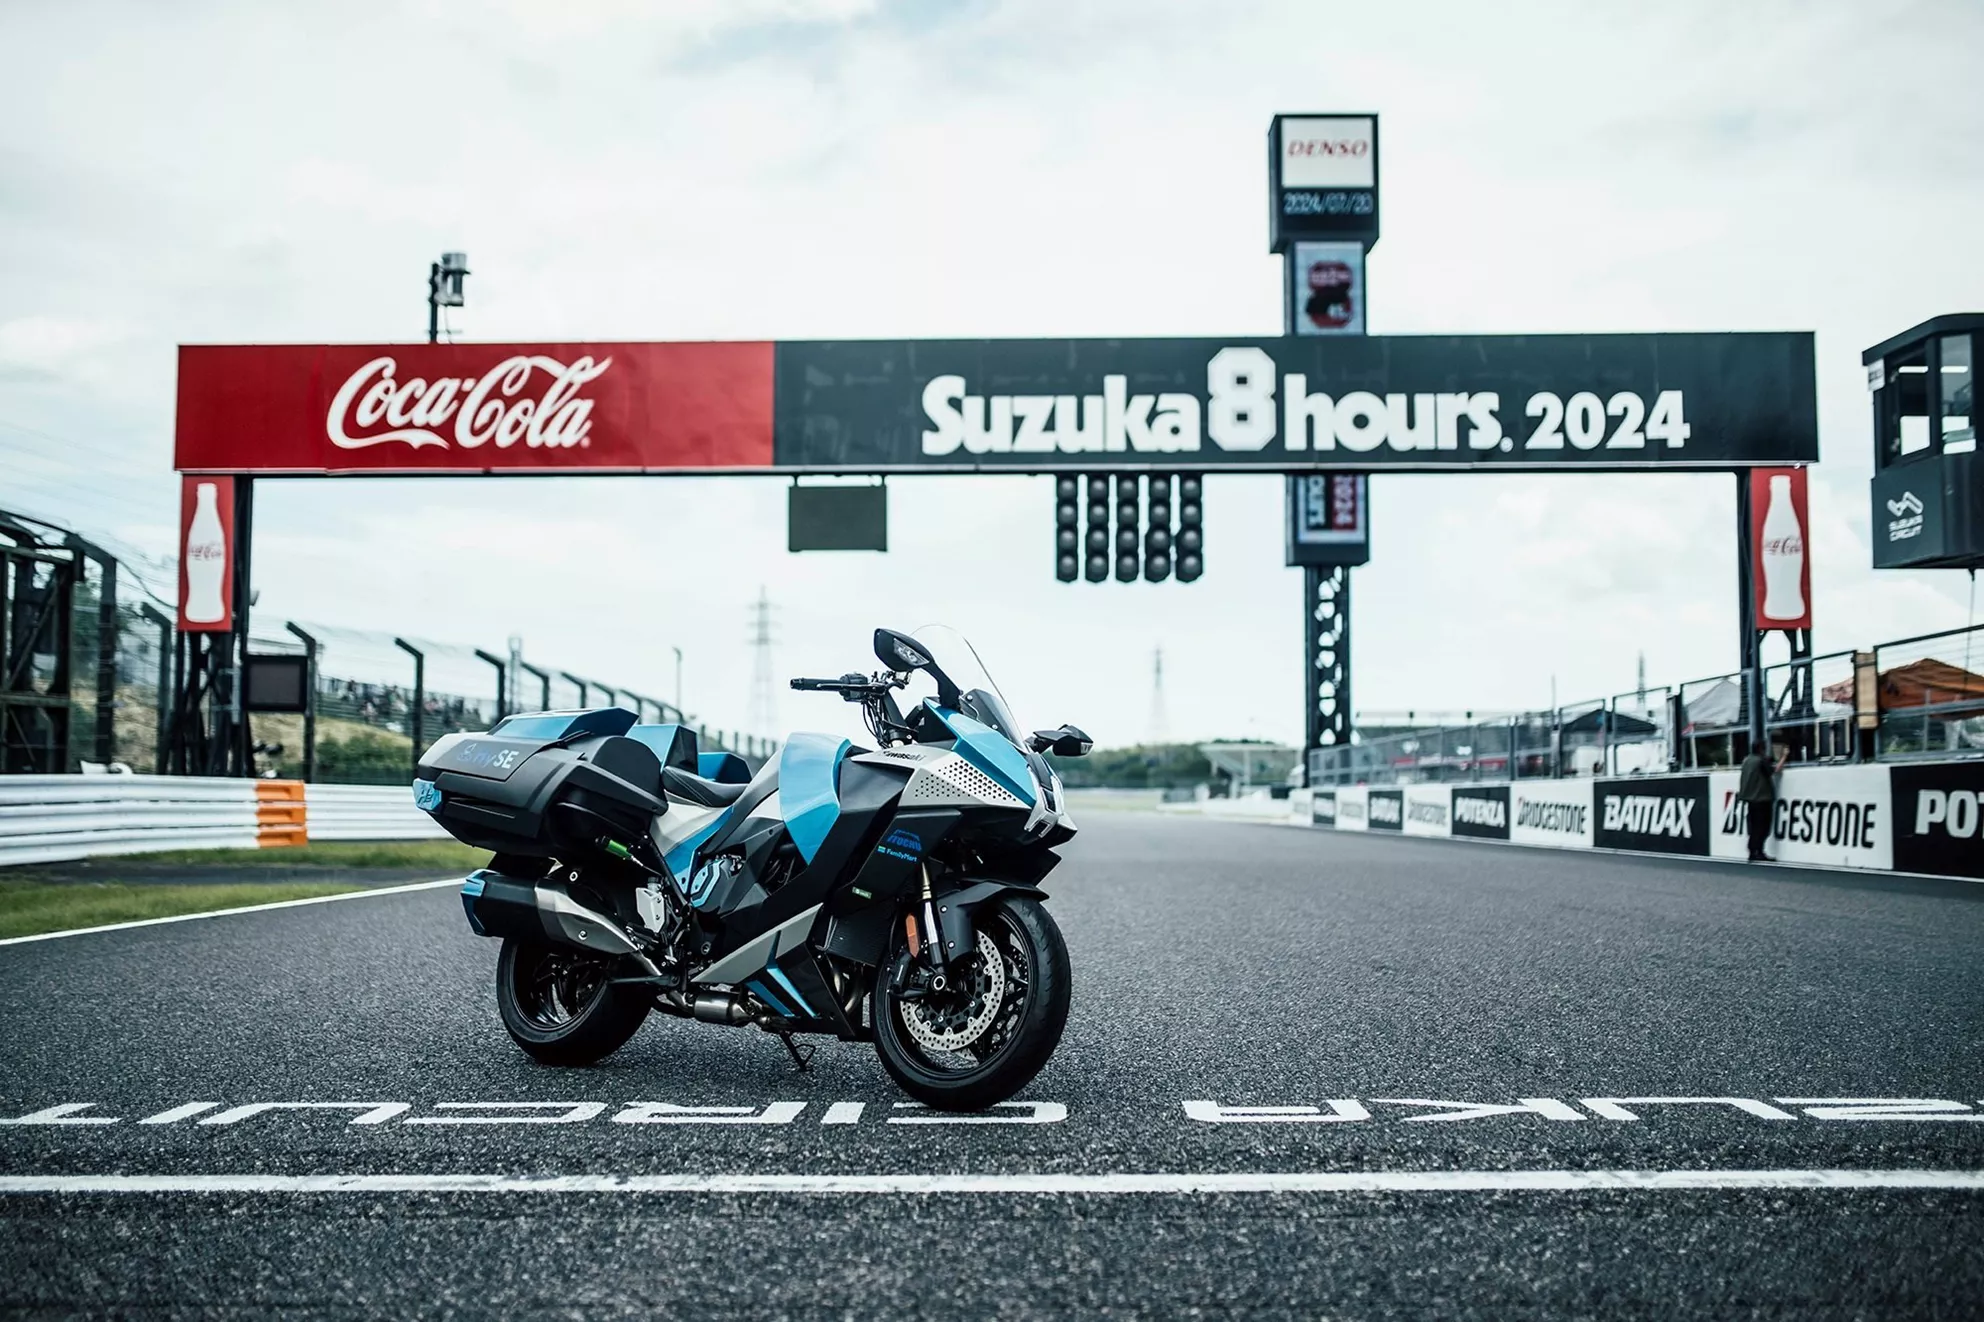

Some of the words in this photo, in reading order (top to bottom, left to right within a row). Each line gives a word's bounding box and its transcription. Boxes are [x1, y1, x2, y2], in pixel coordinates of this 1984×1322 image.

[1288, 140, 1367, 156] DENSO
[327, 356, 612, 449] Coca-Cola
[922, 374, 1200, 455] Suzuka
[1207, 347, 1276, 451] 8
[1525, 390, 1690, 450] 2024
[1455, 797, 1506, 827] POTENZA
[1518, 797, 1587, 834] BRIDGESTONE
[886, 848, 918, 862] FamilyMart
